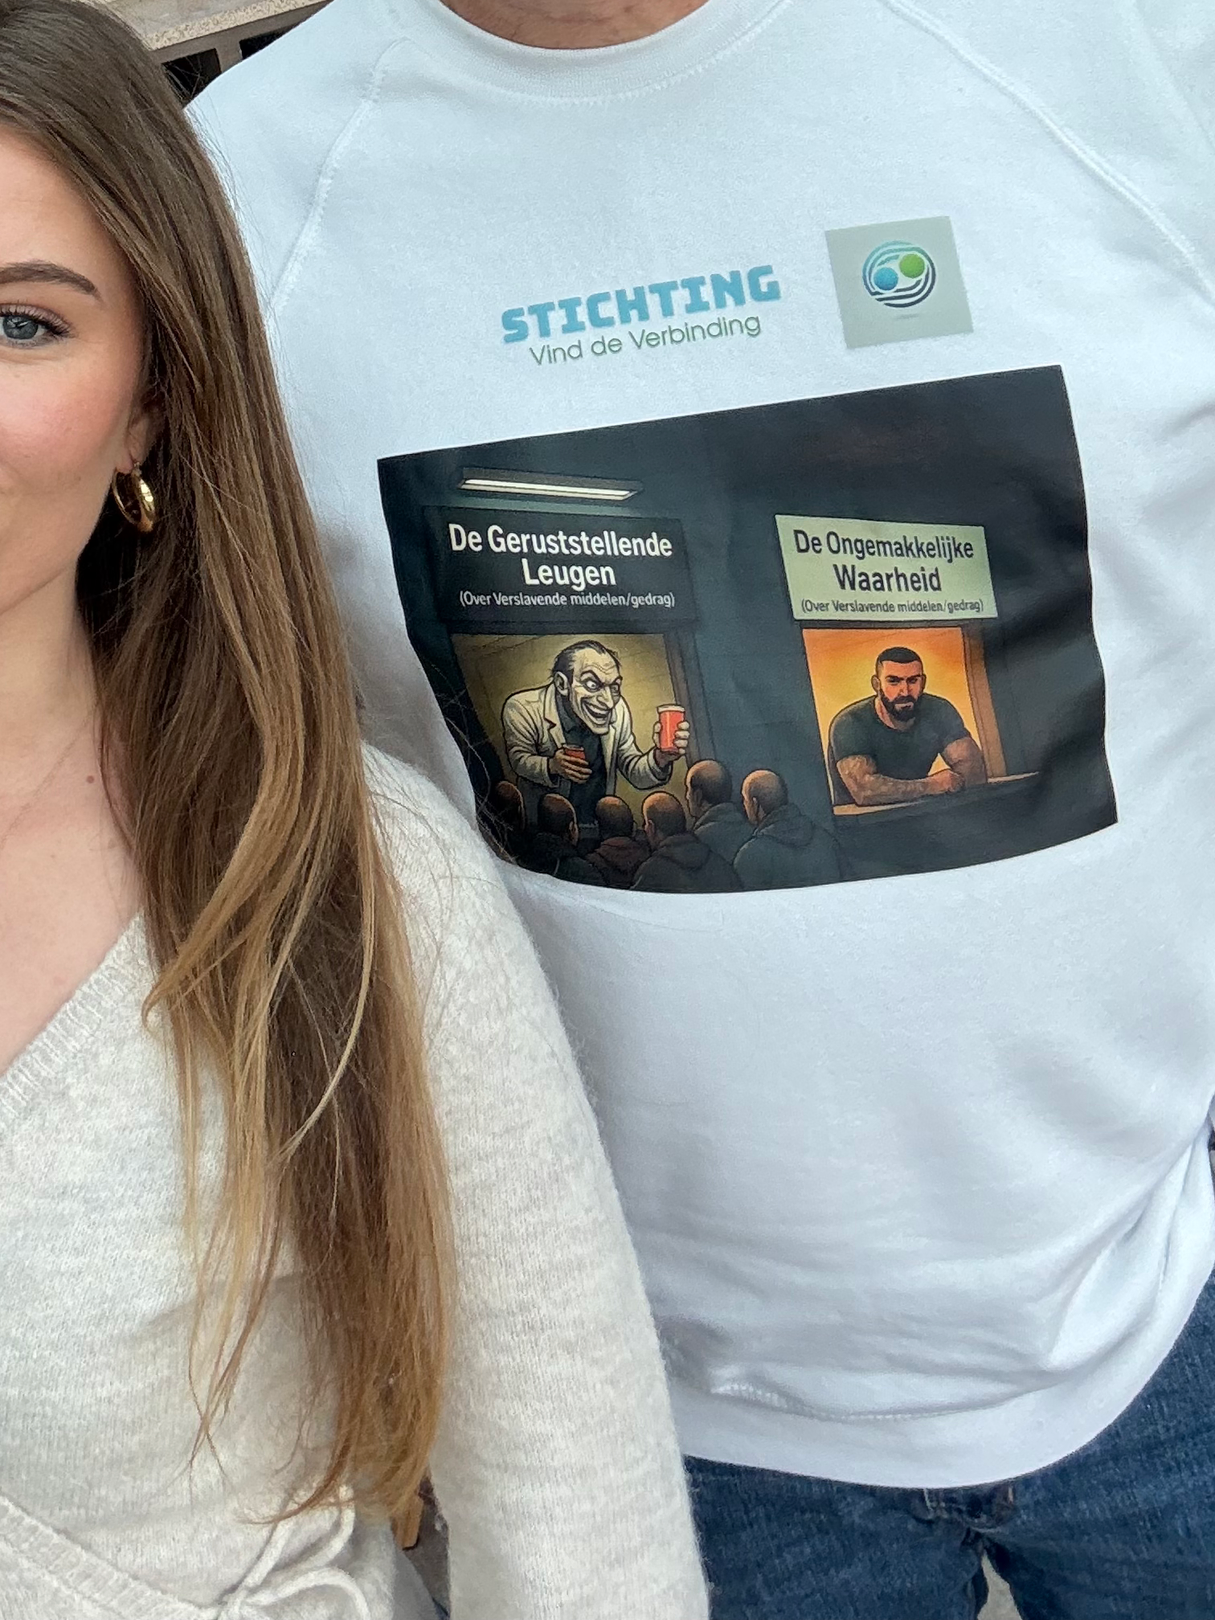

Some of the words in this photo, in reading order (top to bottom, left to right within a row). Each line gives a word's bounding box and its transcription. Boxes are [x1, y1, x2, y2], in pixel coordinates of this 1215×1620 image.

[501, 264, 781, 343] STICHTING
[529, 340, 583, 365] Vind
[590, 336, 623, 357] de
[628, 316, 761, 350] Verbinding
[448, 523, 483, 552] De
[487, 524, 673, 557] Geruststellende
[793, 529, 822, 554] De
[826, 531, 974, 564] Ongemakkelijke
[521, 558, 617, 591] Leugen
[832, 563, 942, 592] Waarheid
[460, 590, 492, 607] (Over
[494, 591, 567, 607] Verslavende
[570, 591, 675, 609] middelen/gedrag)
[801, 598, 830, 614] (Over
[833, 599, 895, 614] Verslavende
[897, 598, 984, 615] middelen/gedrag)
